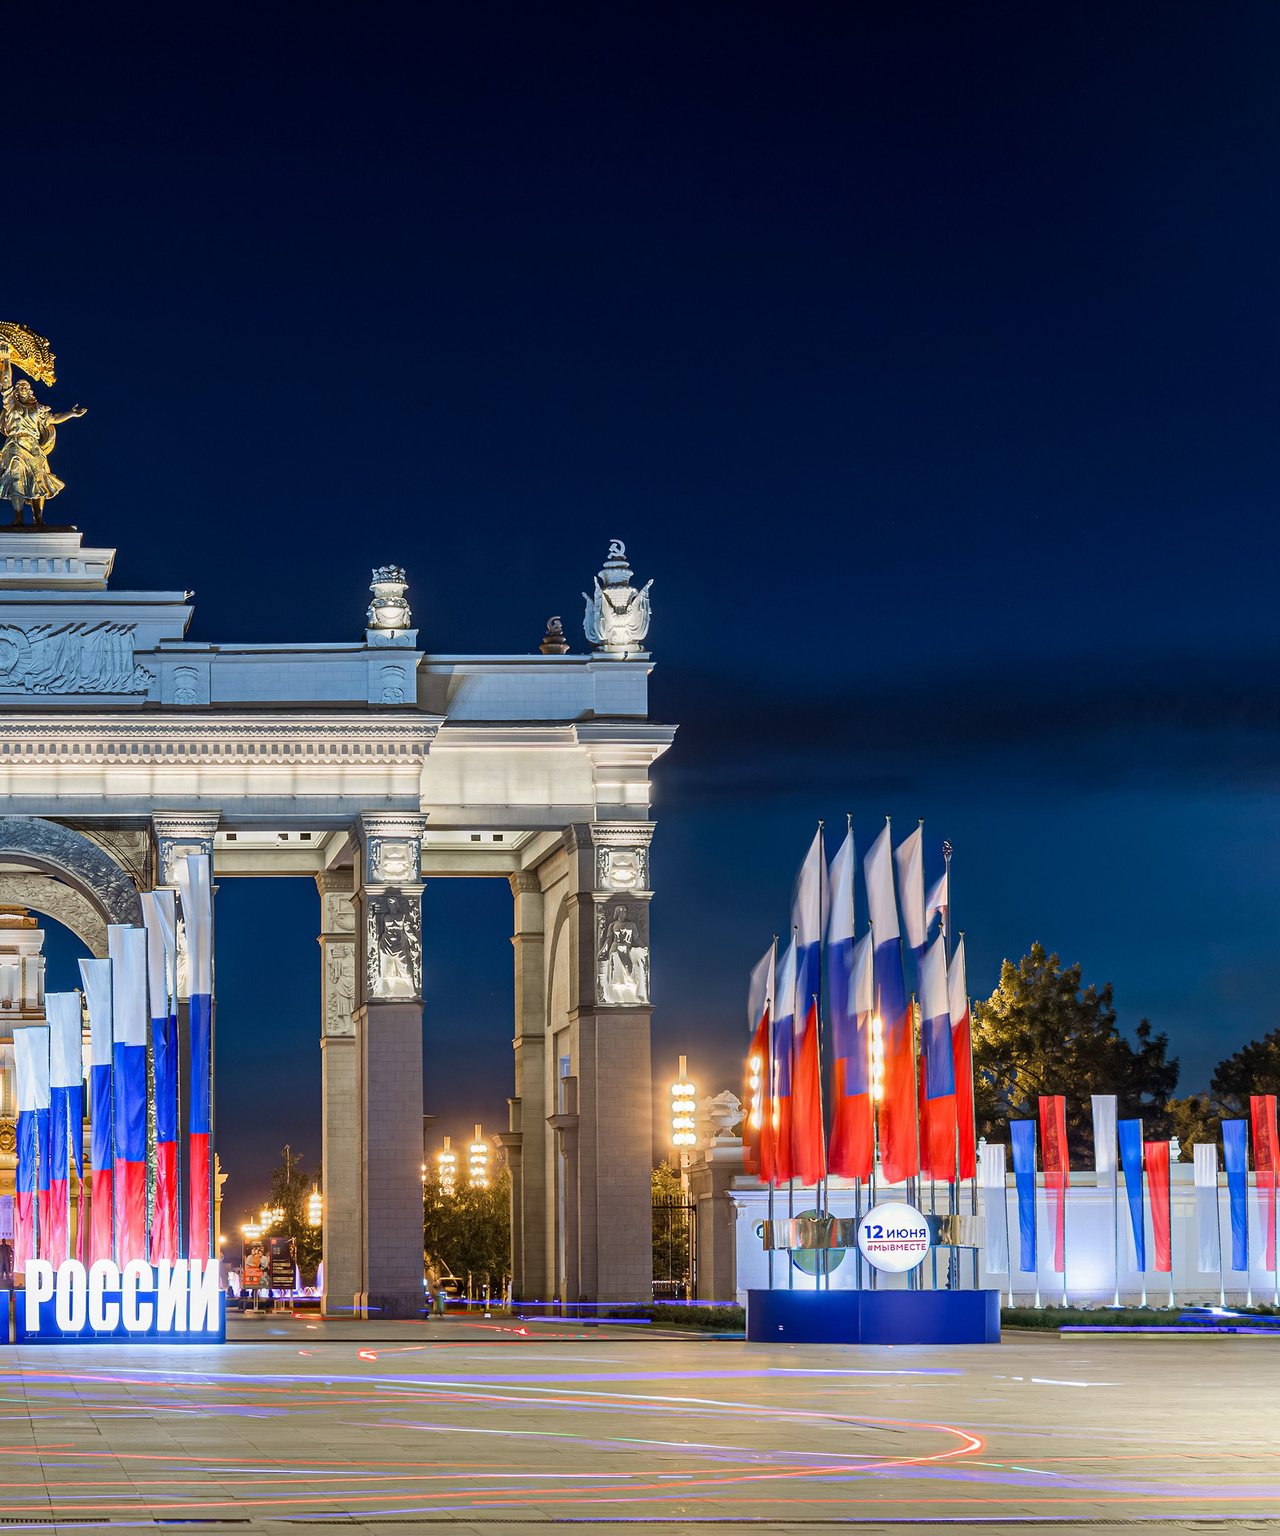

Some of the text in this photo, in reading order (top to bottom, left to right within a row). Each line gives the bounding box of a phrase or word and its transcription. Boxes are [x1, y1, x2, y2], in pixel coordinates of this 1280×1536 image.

[864, 1225, 926, 1239] 12 ИЮНЯ
[867, 1243, 926, 1251] #МЫВМЕСТЕ
[25, 1258, 220, 1331] РОССИИ
